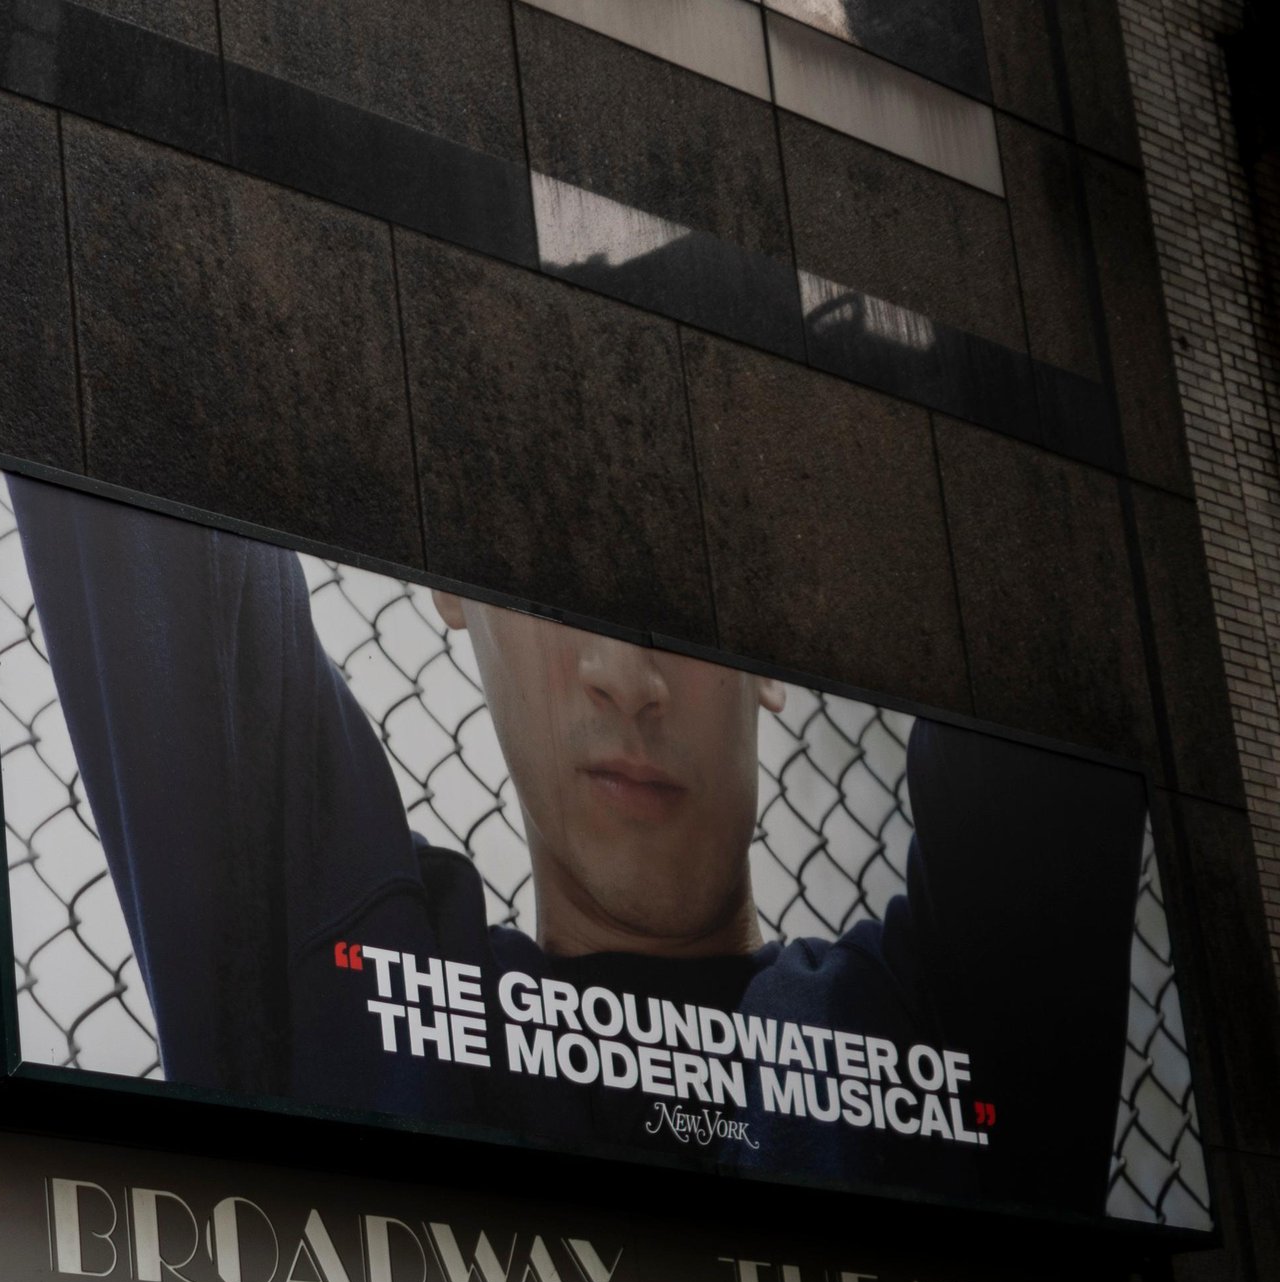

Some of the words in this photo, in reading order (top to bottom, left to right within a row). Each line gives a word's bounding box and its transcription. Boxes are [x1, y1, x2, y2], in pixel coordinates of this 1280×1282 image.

[368, 1000, 491, 1066] THE
[506, 1026, 748, 1108] MODERN
[498, 969, 897, 1084] GROUNDWATER
[911, 1042, 972, 1094] OF
